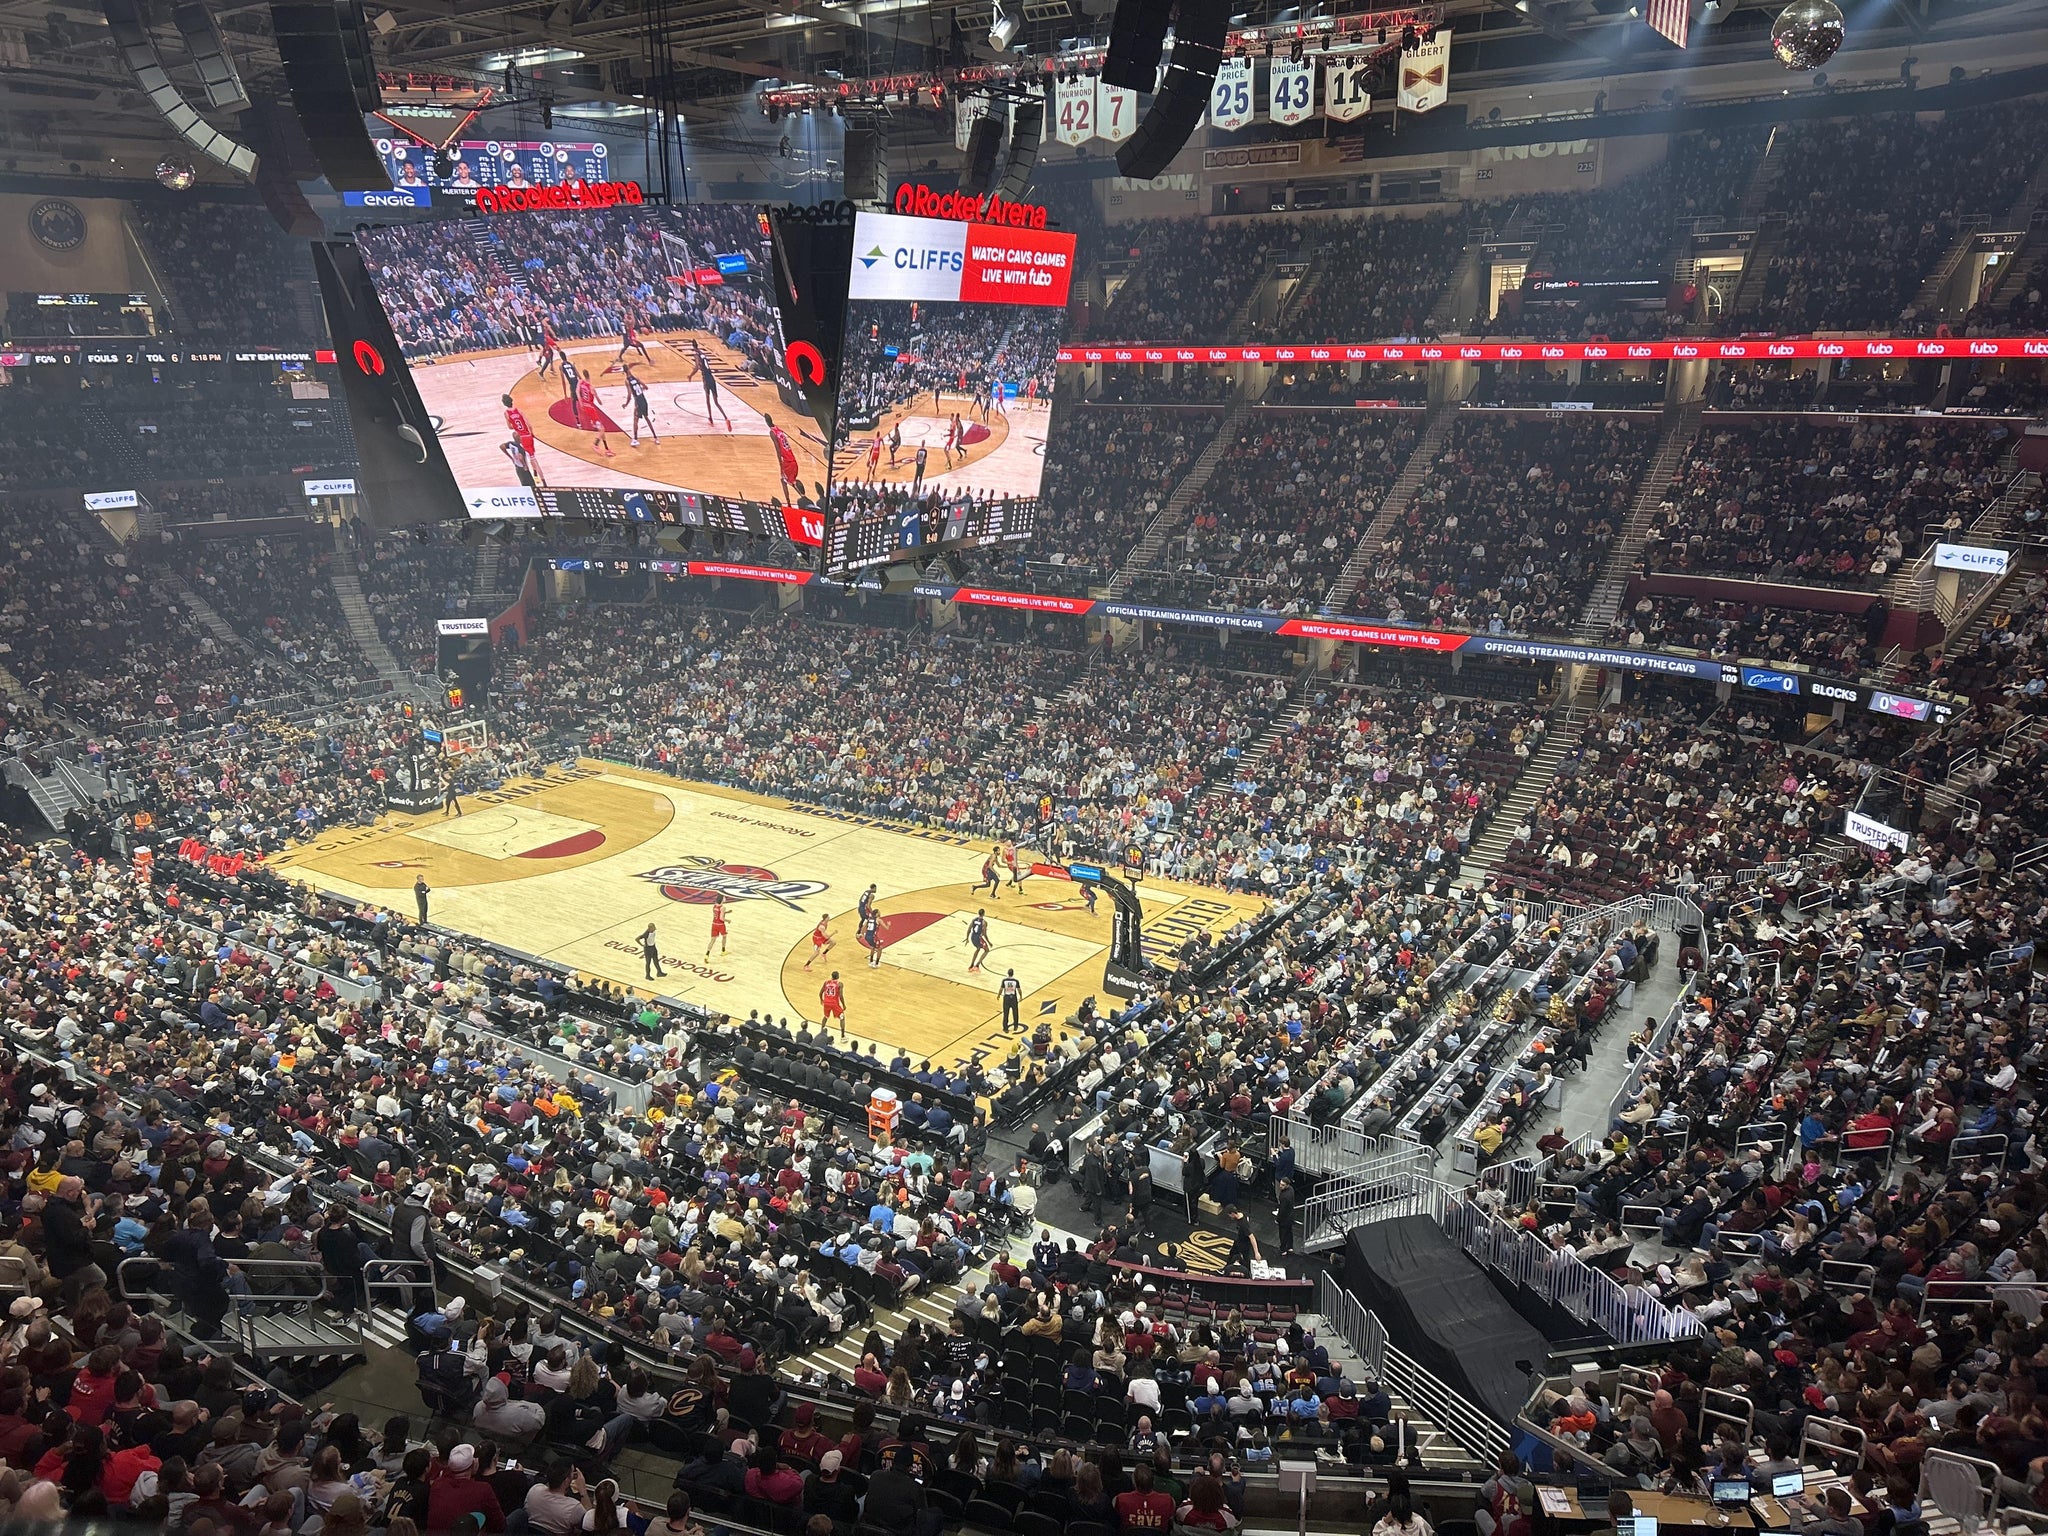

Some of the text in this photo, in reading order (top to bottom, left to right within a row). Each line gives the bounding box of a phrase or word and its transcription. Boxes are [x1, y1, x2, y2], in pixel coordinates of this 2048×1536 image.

[1406, 46, 1444, 58] GILBERT
[1222, 70, 1245, 80] PRICE
[1058, 88, 1092, 98] THURMOND
[1275, 75, 1309, 110] 43
[1333, 71, 1362, 105] 11
[1216, 82, 1249, 116] 25
[387, 108, 456, 118] KNOW.
[1060, 100, 1090, 130] 42
[1110, 96, 1123, 126] 7
[1578, 162, 1594, 172] 225
[1478, 170, 1492, 180] 224
[494, 178, 644, 212] Rocket Arena
[36, 202, 76, 217] CLEVELAND
[915, 184, 1047, 229] Rocket Arena
[42, 236, 78, 248] MONSTERS
[895, 248, 963, 272] CLIFFS
[972, 246, 1066, 267] WATCH CAVS GAMES
[982, 268, 1052, 286] LIVE WITH fubo
[1546, 281, 1568, 289] KeyBank
[1085, 351, 1102, 360] fubo
[1115, 351, 1132, 360] fubo
[1146, 351, 1162, 360] fubo
[1177, 351, 1194, 359] fubo
[1209, 350, 1227, 359] fubo
[1242, 350, 1260, 359] fubo
[1276, 350, 1294, 359] fubo
[1310, 349, 1329, 359] fubo
[1346, 349, 1366, 358] fubo
[1383, 348, 1403, 358] fubo
[1421, 348, 1442, 358] fubo
[1460, 348, 1481, 358] fubo
[1500, 347, 1522, 357] fubo
[1542, 347, 1564, 357] fubo
[1584, 346, 1607, 357] fubo
[1628, 346, 1651, 356] fubo
[1673, 345, 1697, 356] fubo
[1720, 345, 1745, 356] fubo
[1768, 344, 1794, 356] fubo
[1817, 344, 1844, 355] fubo
[1866, 343, 1893, 355] fubo
[1917, 342, 1944, 354] fubo
[1970, 342, 1998, 354] fubo
[35, 354, 70, 364] FG% 0
[88, 354, 133, 363] FOULS 2
[171, 354, 178, 363] 6
[209, 353, 221, 361] PM
[236, 353, 311, 362] LET EM KNOW.
[515, 419, 523, 430] 3
[104, 495, 135, 504] CLIFFS
[491, 498, 536, 507] CLIFFS
[668, 494, 676, 502] 14
[636, 507, 644, 518] 8
[659, 511, 675, 522] 9:40
[688, 511, 696, 522] 0
[921, 509, 947, 522] 1Q 14
[951, 526, 957, 537] 0
[907, 533, 912, 544] 8
[926, 533, 938, 543] 9:40
[583, 560, 590, 569] 8
[1962, 554, 2004, 566] CLIFFS
[925, 588, 942, 596] CAVS
[1008, 596, 1028, 604] GAMES
[1042, 599, 1057, 608] WITH
[1059, 601, 1073, 609] fubo
[1106, 606, 1262, 628] OFFICIAL STREAMING PARTNER OF THE CAVS
[1302, 625, 1440, 645] WATCH CAVS GAMES LIVE WITH fubo
[1485, 642, 1696, 674] OFFICIAL STREAMING PARTNER OF THE CAVS
[1722, 674, 1737, 684] 100
[1748, 675, 1783, 686] CLEVELAND
[1783, 678, 1793, 691] 0
[1812, 683, 1857, 701] BLOCKS
[1880, 696, 1889, 710] 0
[1935, 705, 1952, 715] FG%
[1936, 714, 1944, 724] 0
[478, 768, 603, 804] CAVALIERS
[710, 811, 804, 837] Arena Rocket
[789, 803, 970, 846] KNOW. EM LET
[1107, 973, 1139, 990] KeyBank
[826, 988, 835, 996] 44
[1128, 1514, 1162, 1526] CAVS
